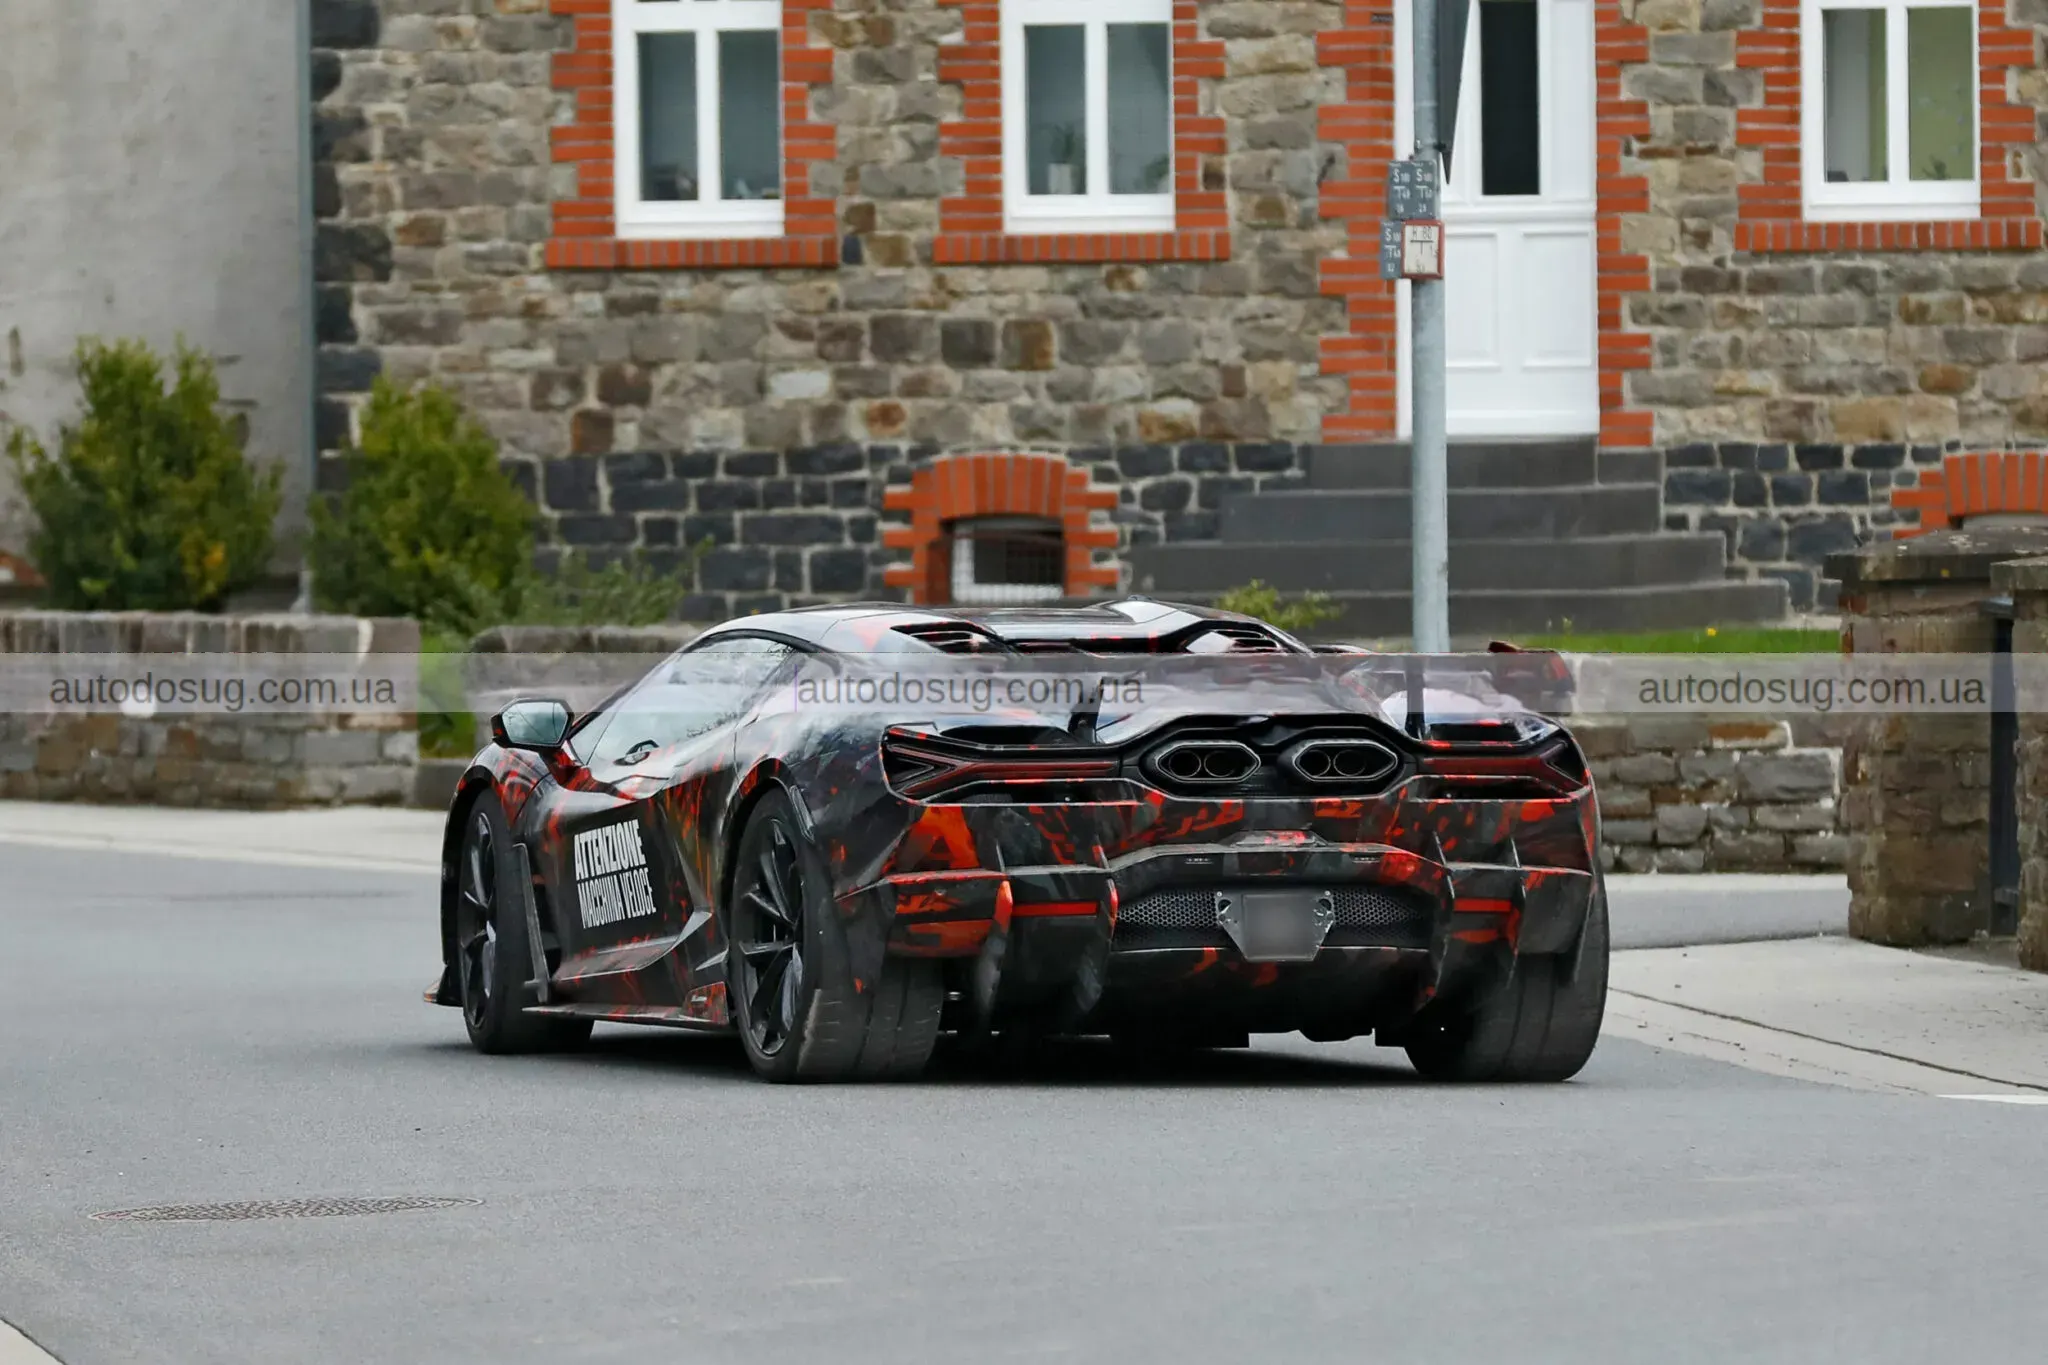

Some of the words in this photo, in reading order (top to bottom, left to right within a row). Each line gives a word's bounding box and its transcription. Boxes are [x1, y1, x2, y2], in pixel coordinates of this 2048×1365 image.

[574, 819, 647, 880] ATTENZIONE
[577, 874, 625, 929] MACCHINA
[619, 867, 657, 919] VELOCE
